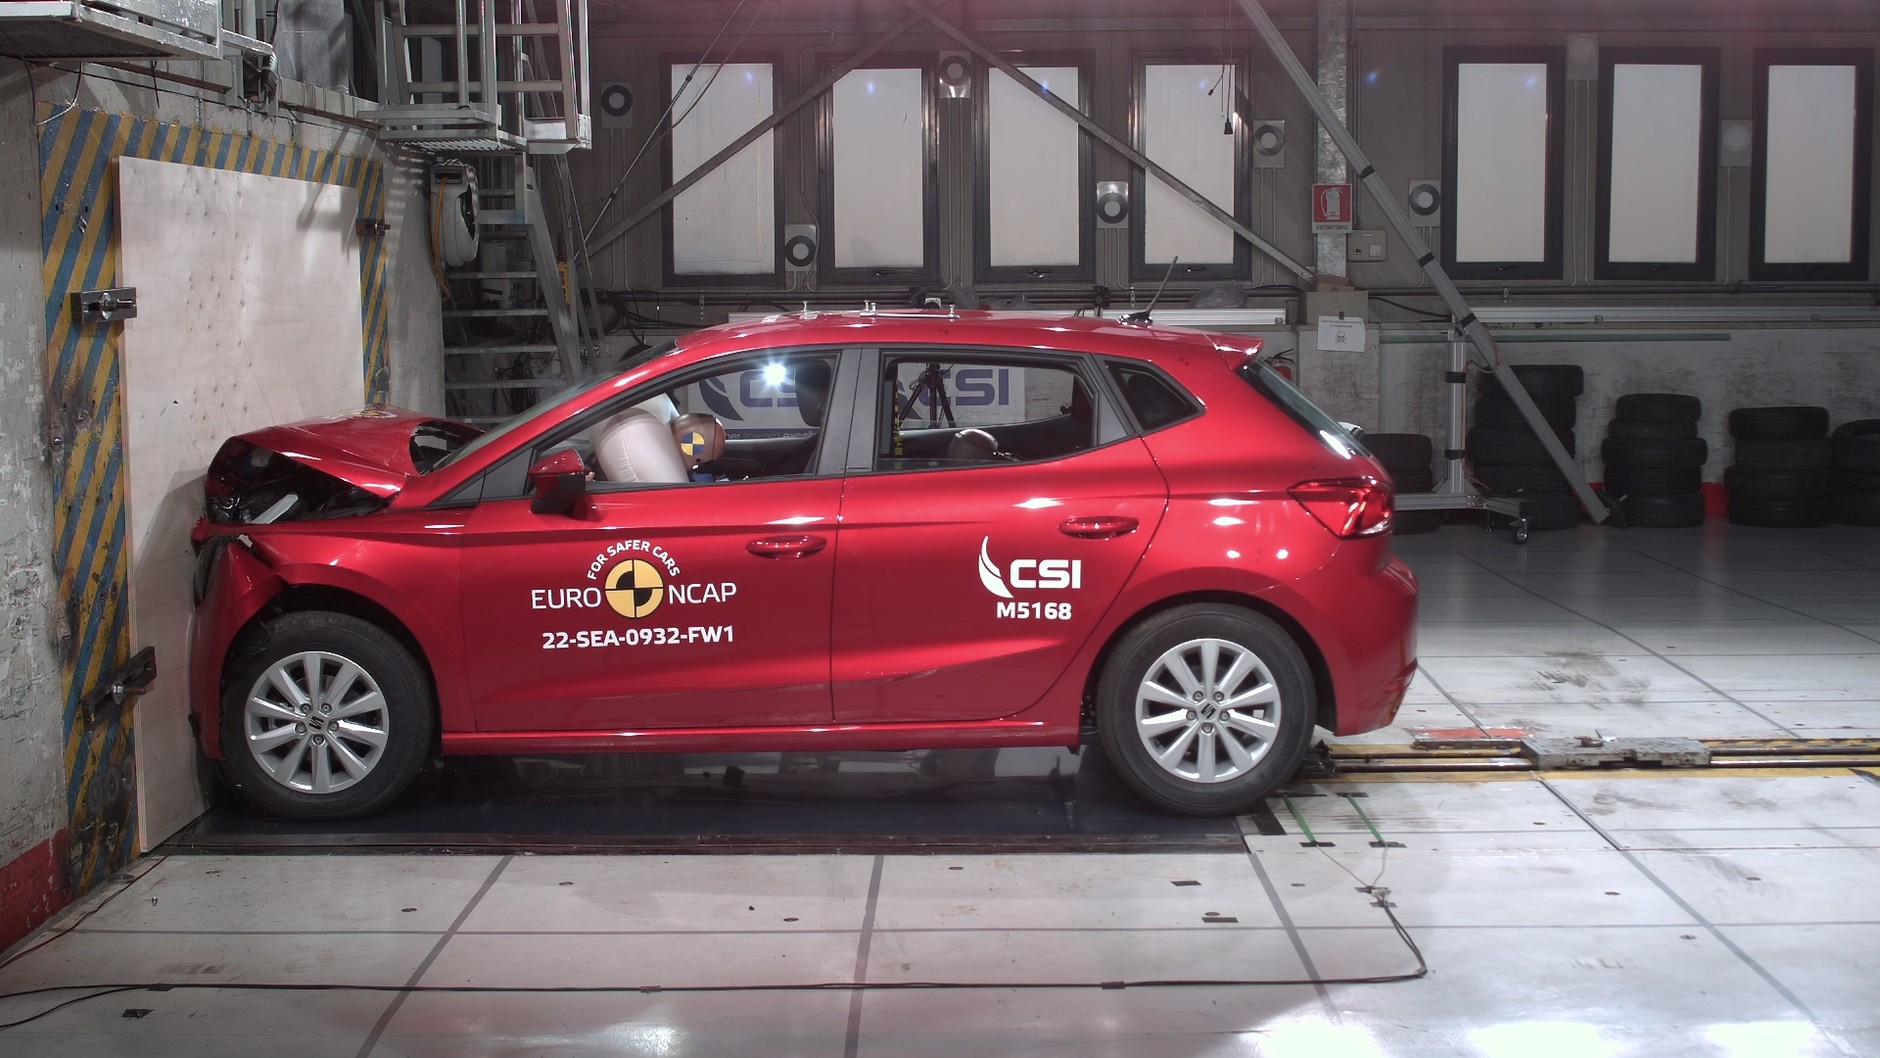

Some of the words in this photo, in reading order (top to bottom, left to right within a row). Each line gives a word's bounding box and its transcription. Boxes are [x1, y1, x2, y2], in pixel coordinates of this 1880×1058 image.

[586, 553, 608, 580] FOR
[606, 539, 651, 557] SAFER
[652, 546, 680, 577] CARS
[1010, 559, 1082, 589] CSI
[531, 587, 601, 609] EURO
[668, 582, 737, 605] NCAP
[996, 601, 1072, 620] M5168
[542, 625, 734, 650] 22-SEA-0932-FW1
